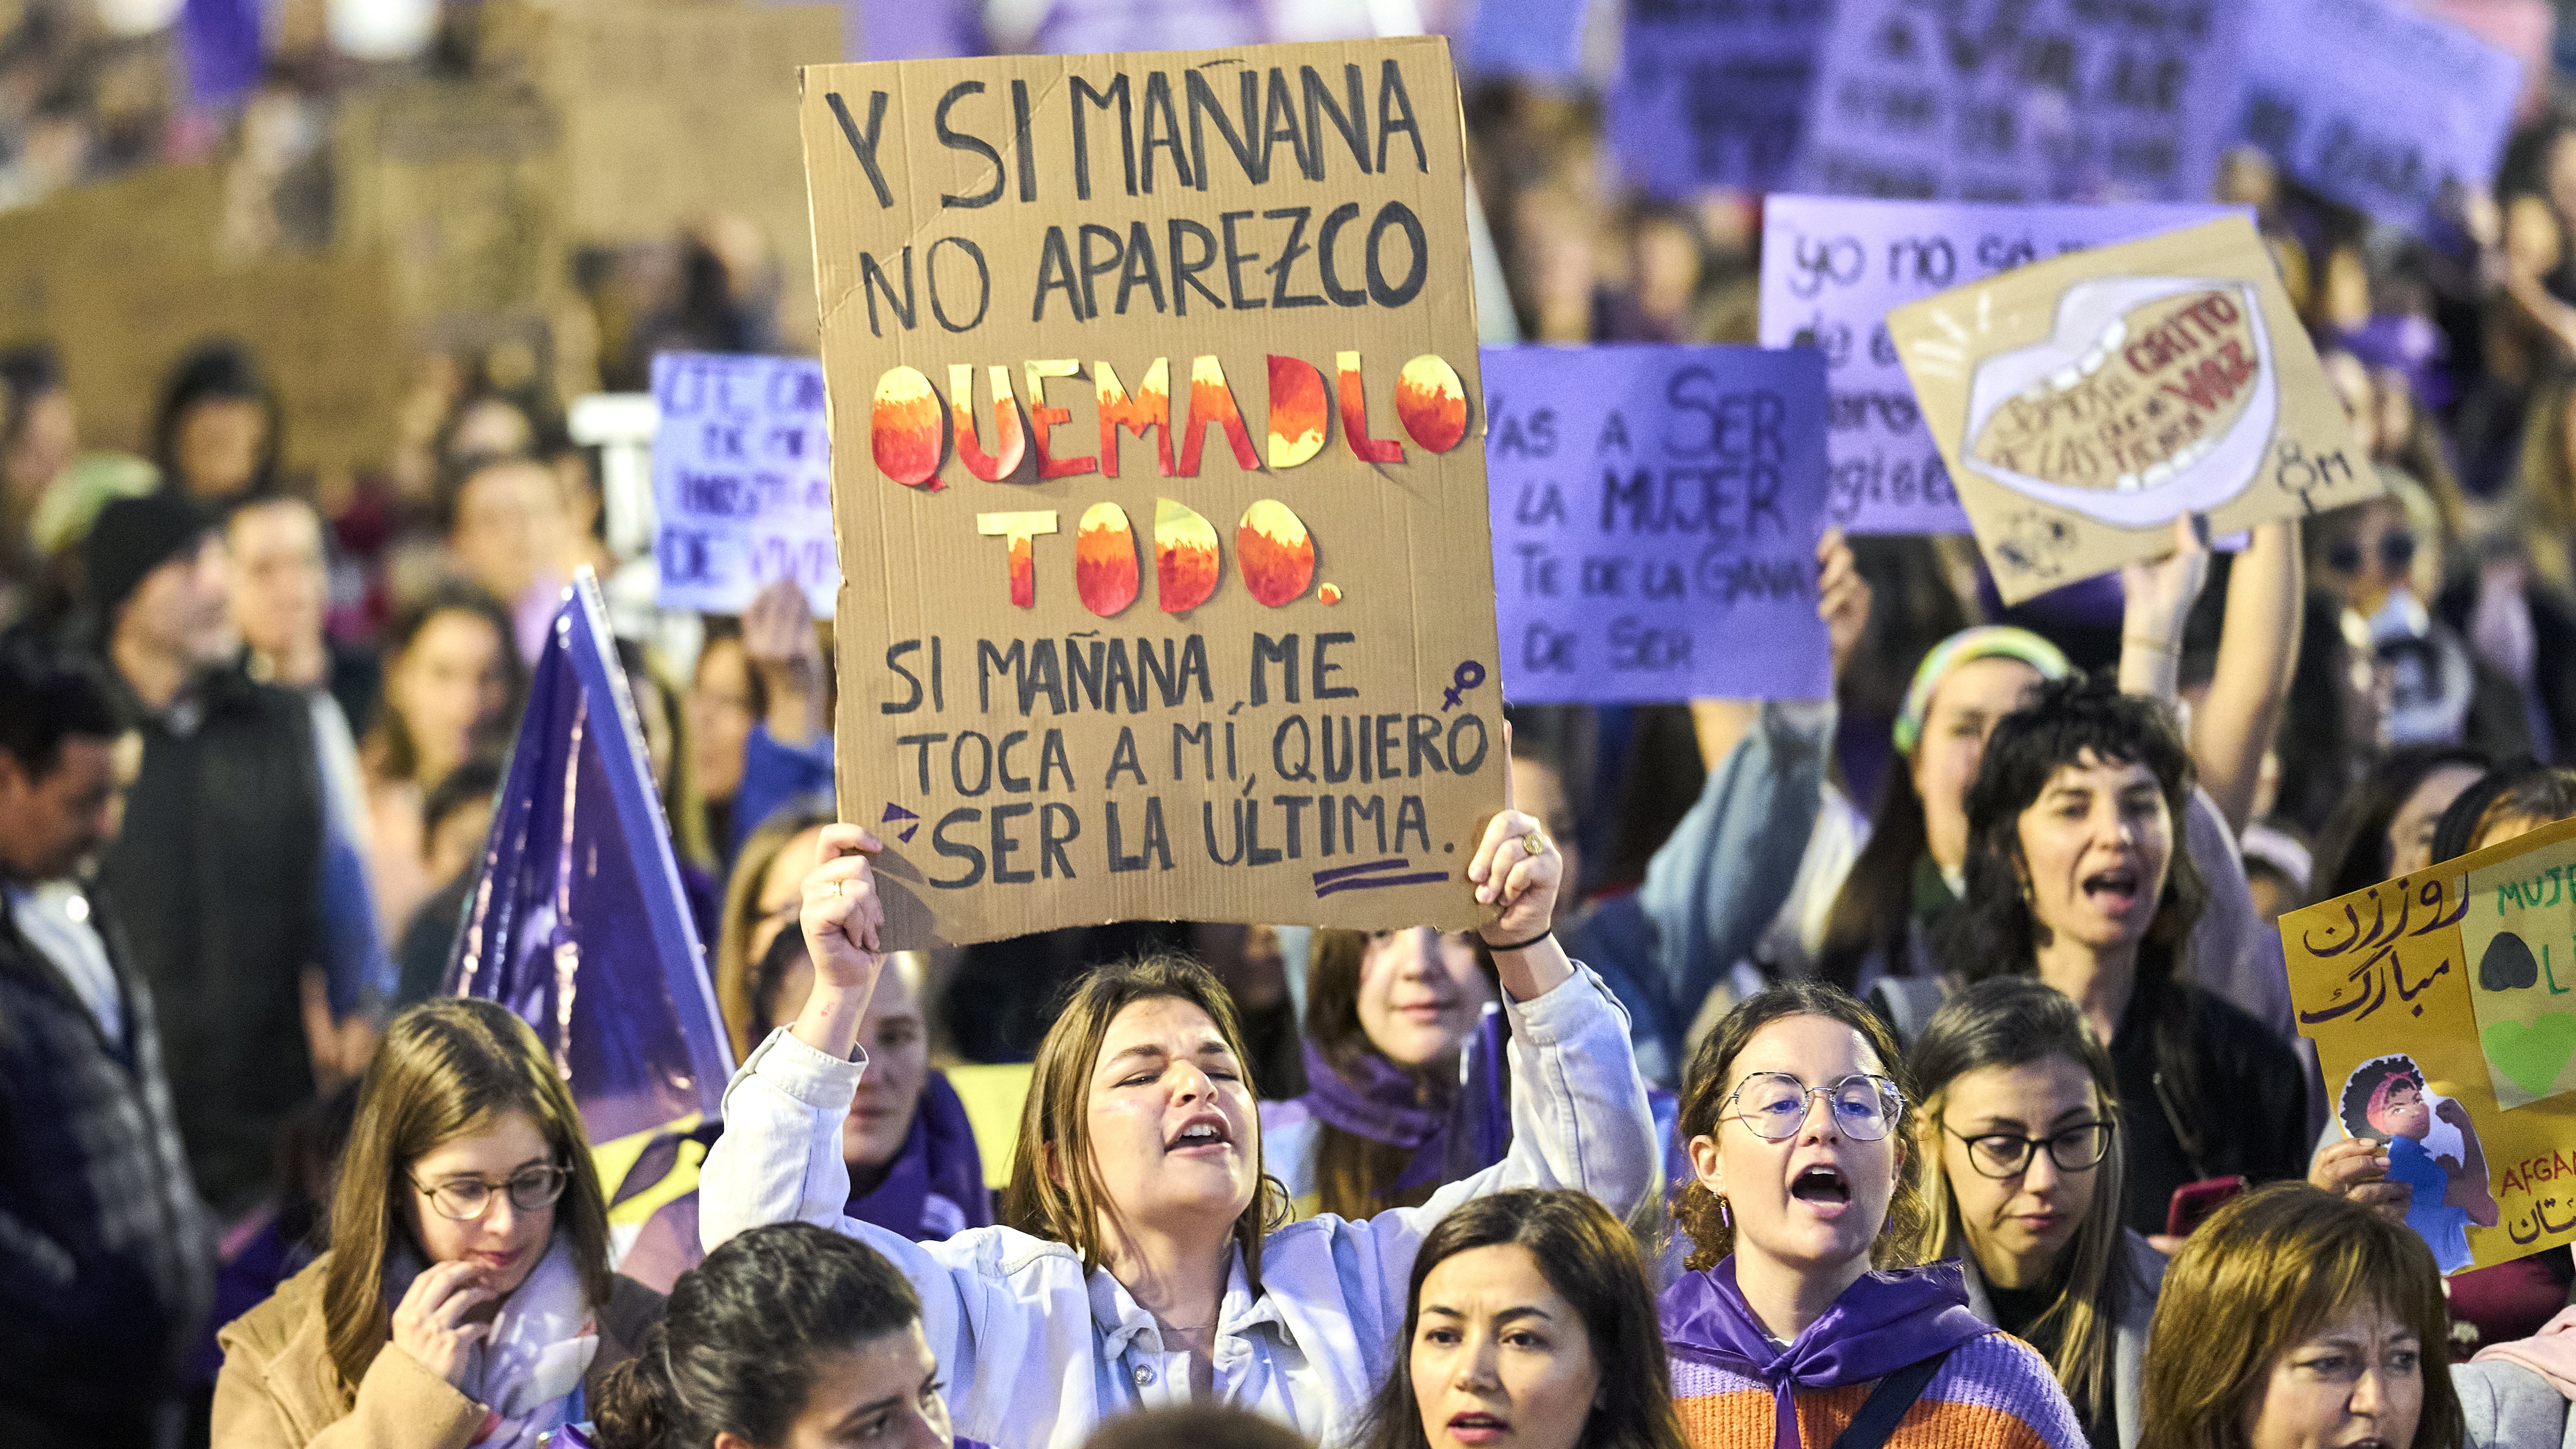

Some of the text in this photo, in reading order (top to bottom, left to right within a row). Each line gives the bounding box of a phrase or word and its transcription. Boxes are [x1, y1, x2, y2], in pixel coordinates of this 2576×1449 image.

[825, 58, 1430, 209] Y SI MAÑANA
[858, 200, 1429, 338] NO APAREZCO
[1788, 234, 1866, 298] yo
[1889, 234, 1957, 288] no
[870, 350, 1468, 492] QUEMADLO
[1598, 410, 1632, 455] A
[1664, 365, 1788, 464] SER
[1515, 466, 1788, 536] LA MUJER
[2275, 439, 2354, 507] 8M
[976, 497, 1343, 618] TODO.
[1513, 541, 1560, 598] TE
[880, 629, 1360, 717] SI MAÑANA ME
[1522, 616, 1694, 672] DE SER
[896, 726, 1076, 796] TOCA
[1104, 725, 1147, 790] A
[1273, 712, 1489, 786] QUIERO
[928, 803, 1080, 891] SER
[1105, 796, 1176, 874] LA
